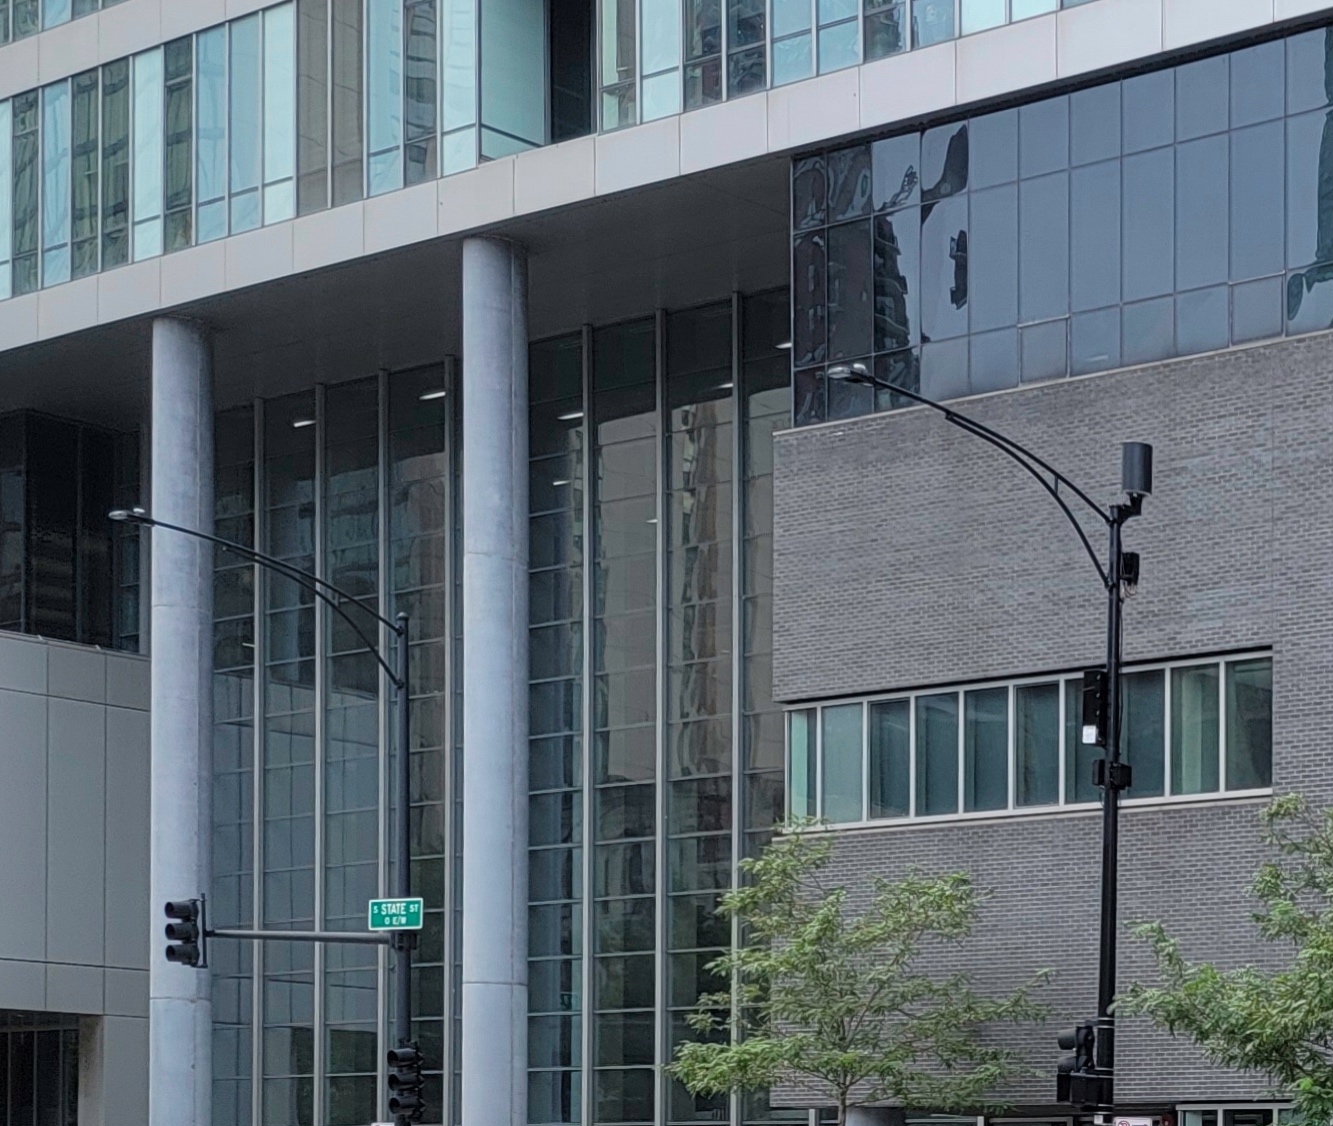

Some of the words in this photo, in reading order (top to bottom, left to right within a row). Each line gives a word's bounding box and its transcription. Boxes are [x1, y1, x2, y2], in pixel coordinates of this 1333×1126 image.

[373, 905, 379, 914] S
[381, 903, 407, 915] STATE
[409, 904, 419, 913] ST
